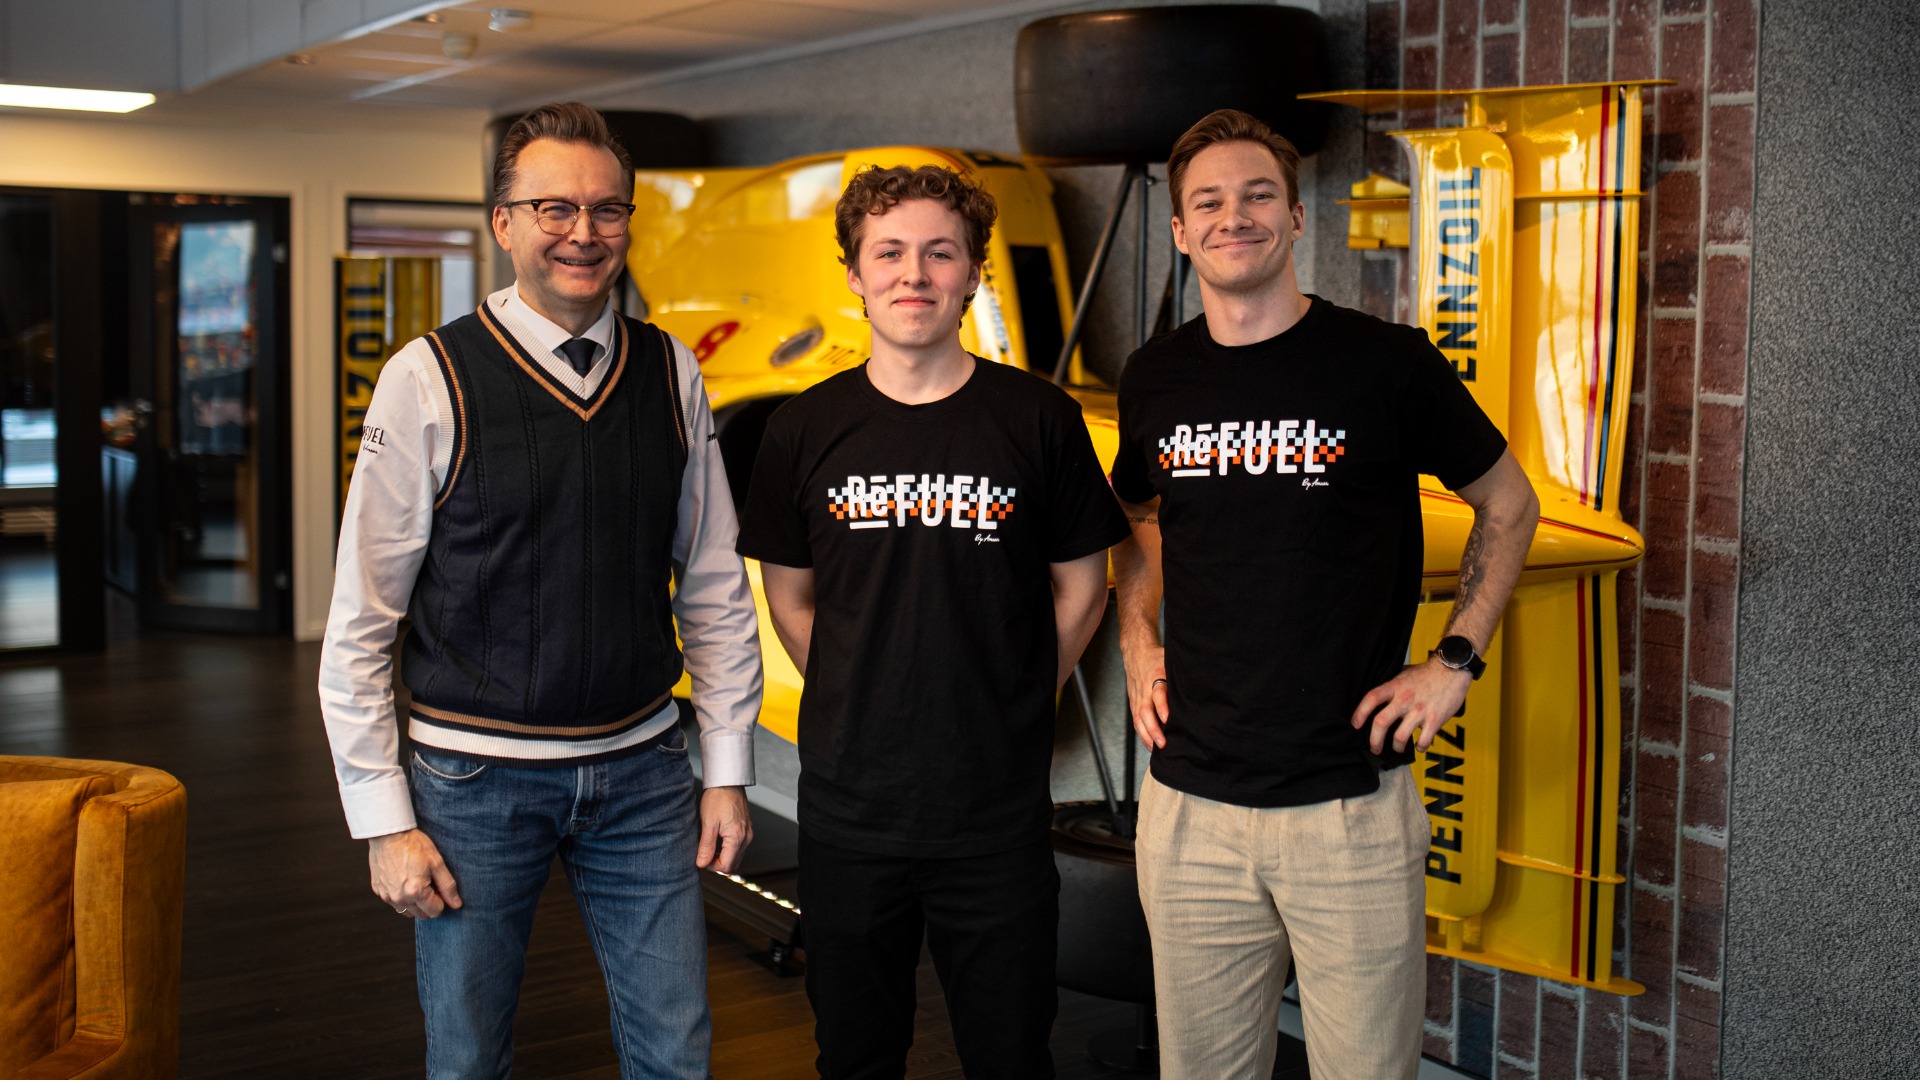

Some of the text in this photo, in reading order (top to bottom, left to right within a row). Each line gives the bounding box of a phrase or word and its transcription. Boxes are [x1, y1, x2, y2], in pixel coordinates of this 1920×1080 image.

[346, 271, 385, 480] ZOIL
[1436, 166, 1481, 383] ENNZOIL
[1424, 650, 1466, 885] PENNZ
